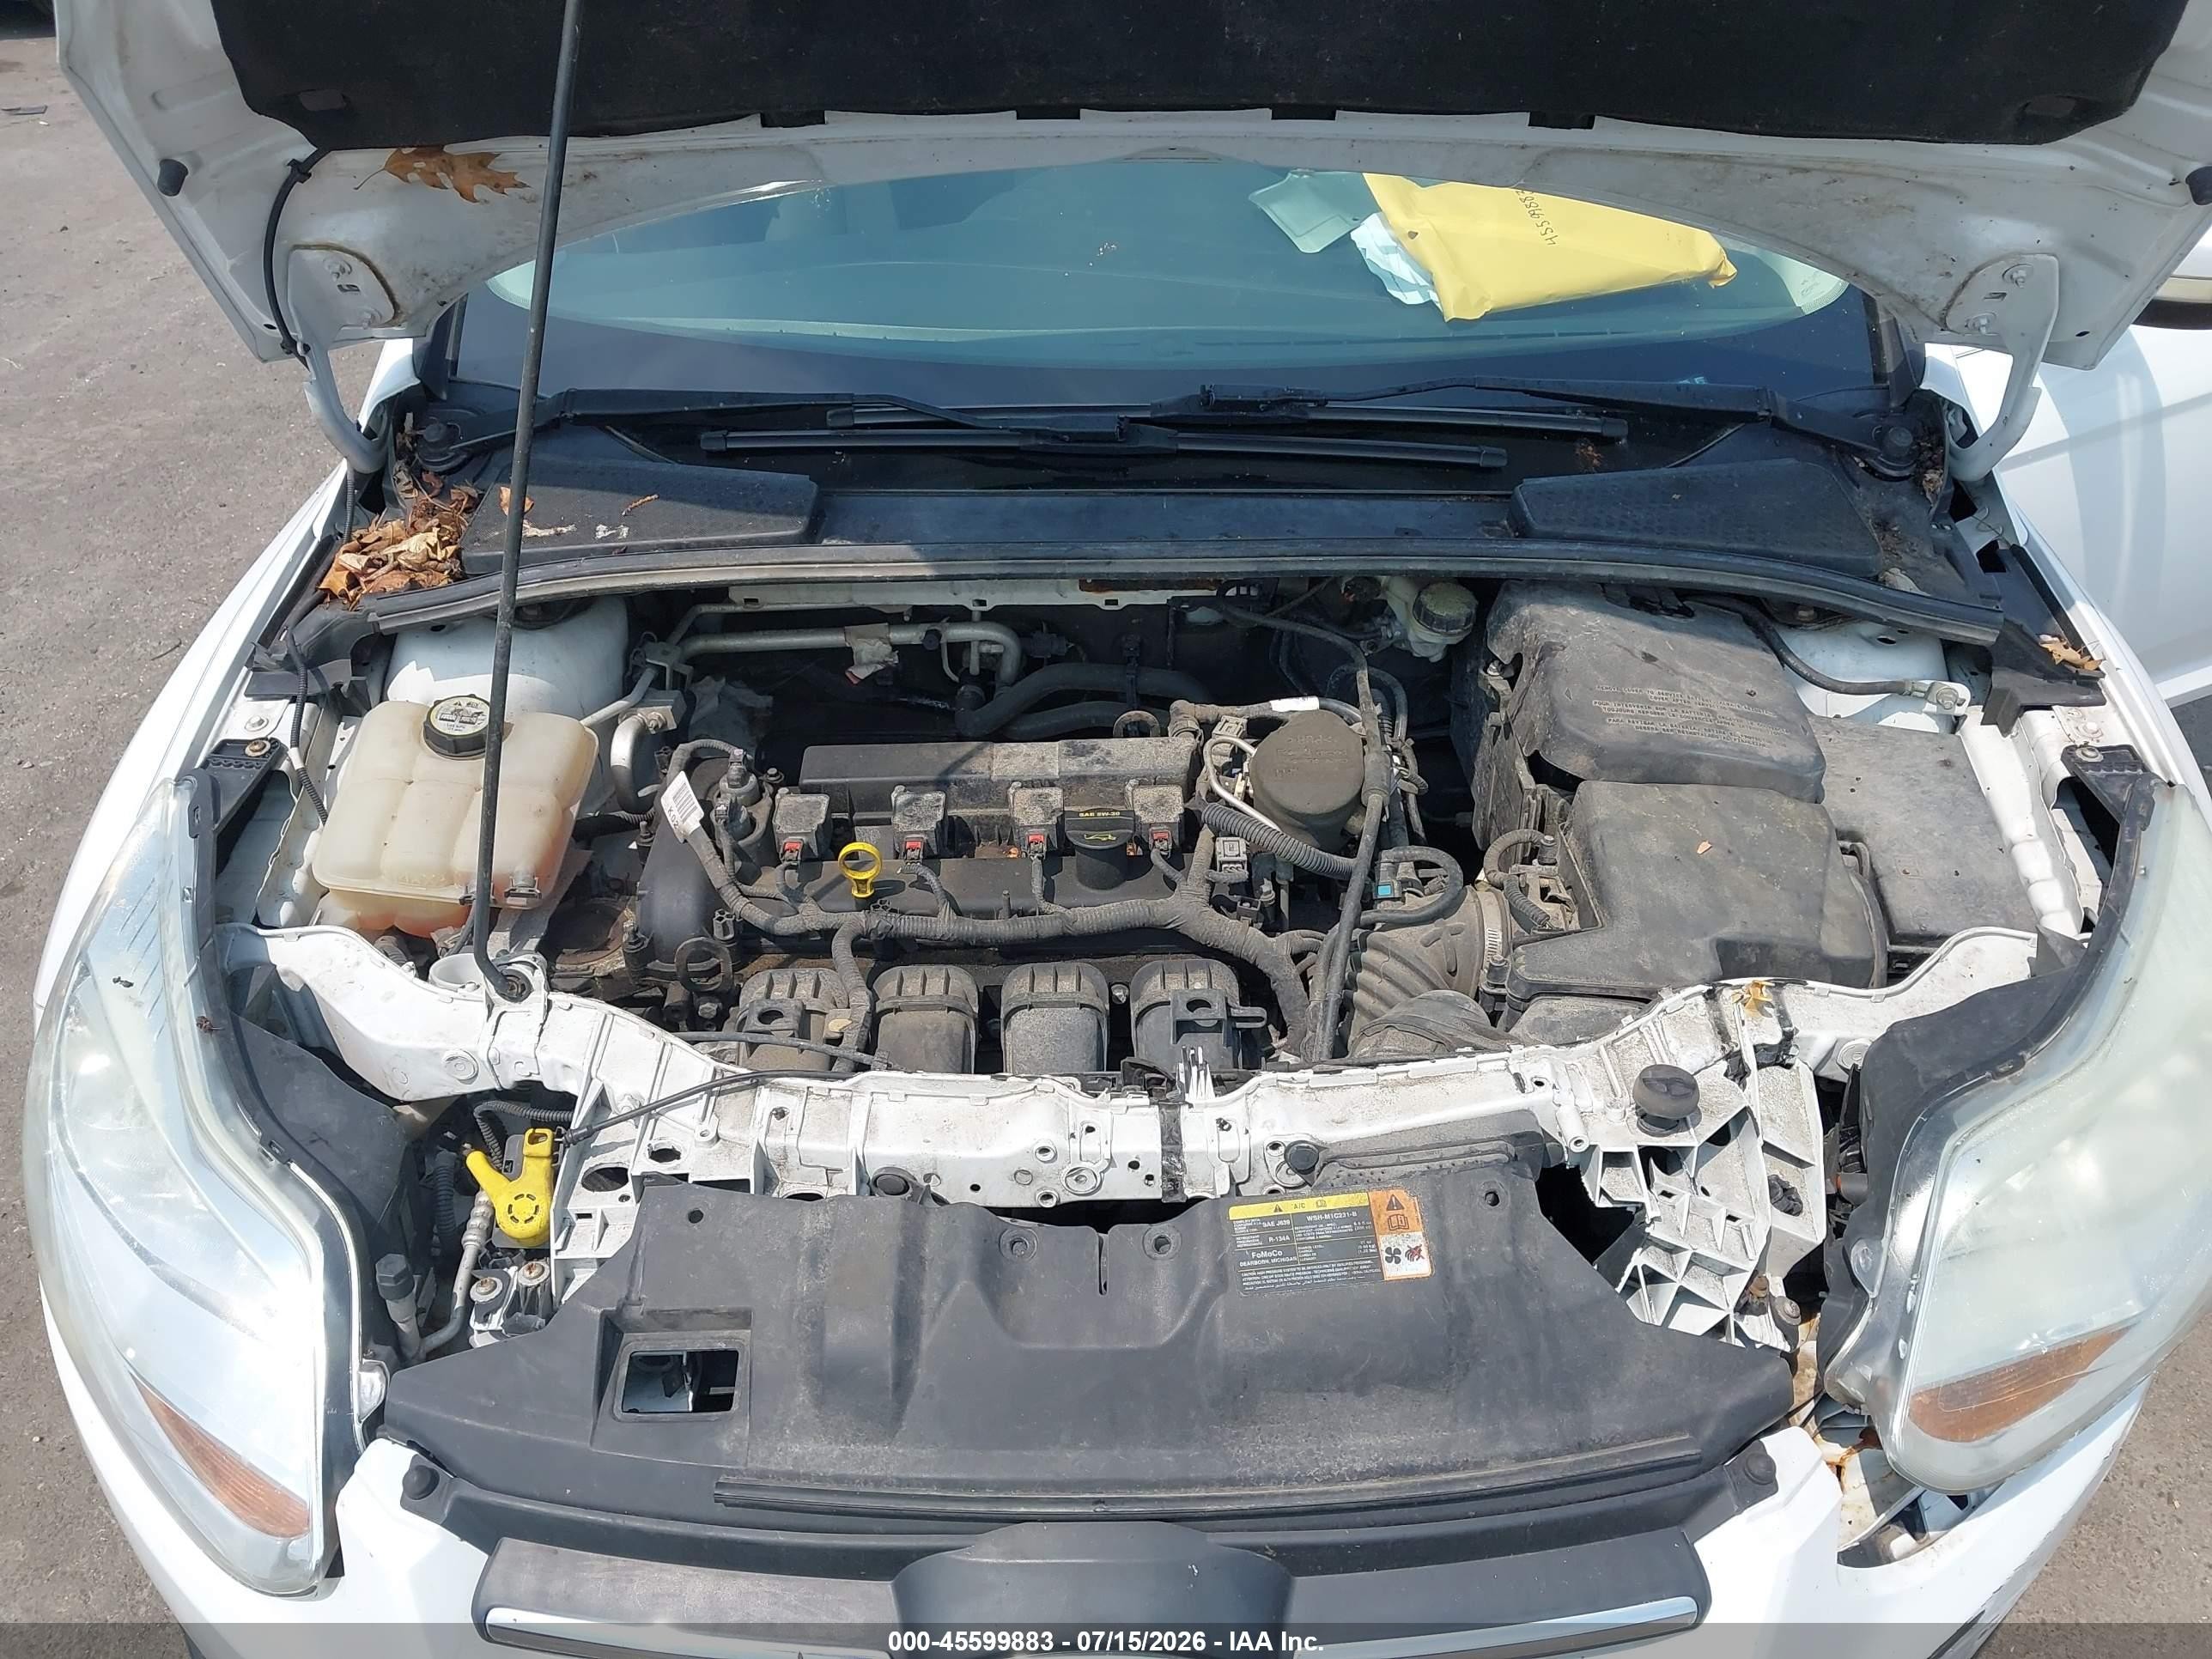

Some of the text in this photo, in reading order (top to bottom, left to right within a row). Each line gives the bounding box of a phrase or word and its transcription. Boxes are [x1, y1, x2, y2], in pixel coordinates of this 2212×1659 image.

[1268, 1234, 1291, 1243] R-134A
[1251, 1249, 1283, 1259] FoMoCo
[1239, 1259, 1271, 1267] DEARBORN,
